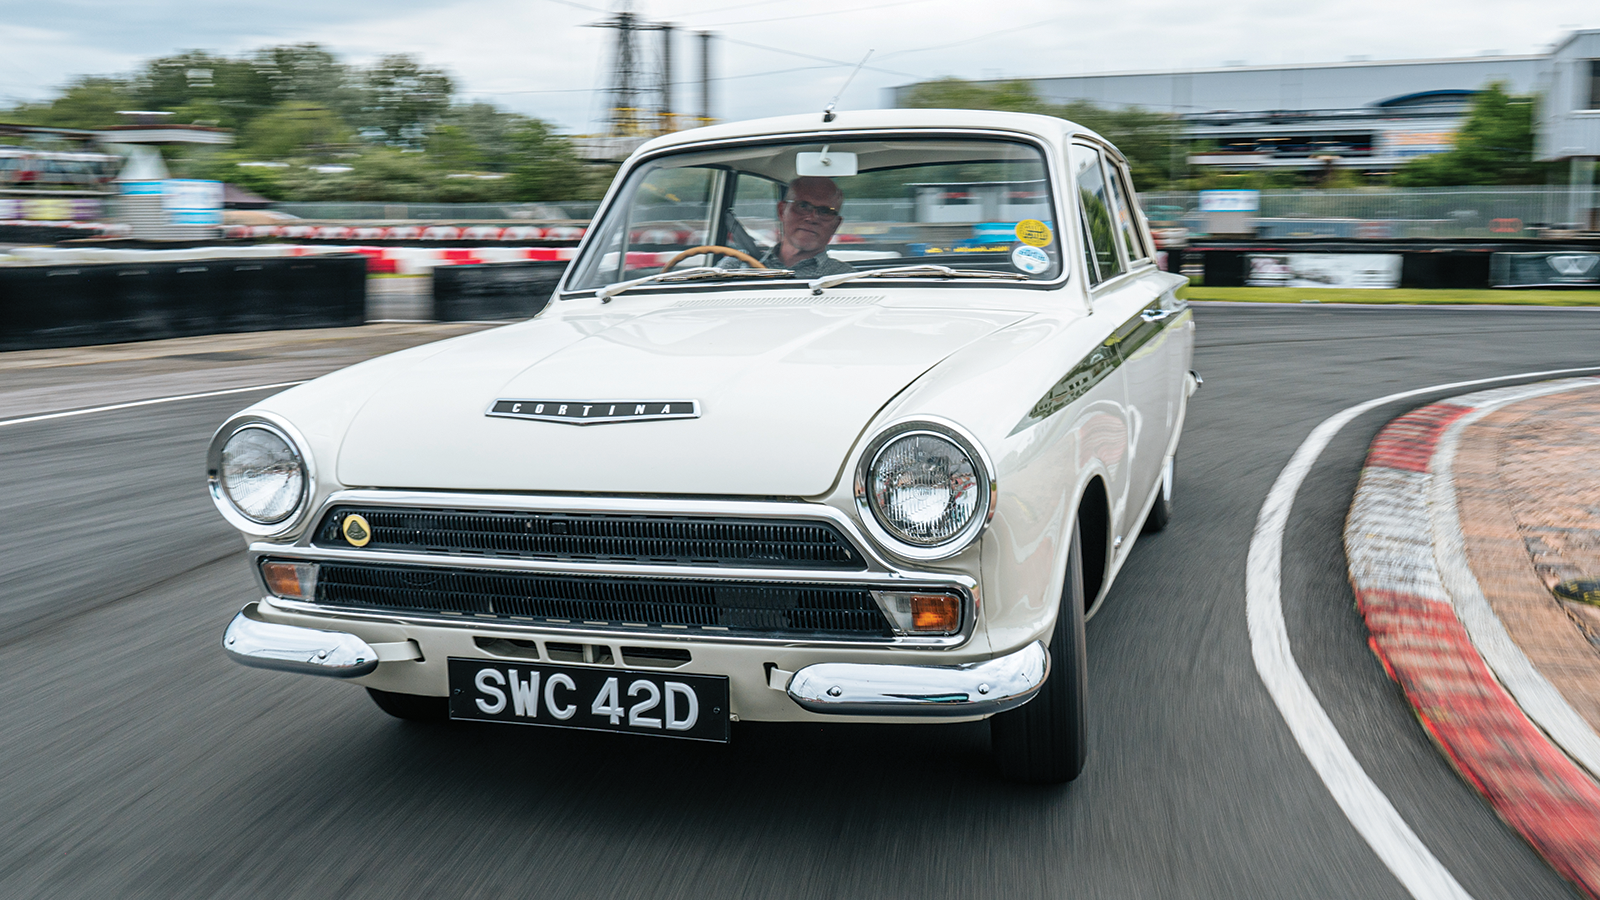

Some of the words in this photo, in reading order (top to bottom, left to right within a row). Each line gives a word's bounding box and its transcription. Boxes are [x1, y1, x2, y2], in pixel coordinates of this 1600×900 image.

[511, 403, 672, 417] CORTINA
[474, 668, 577, 720] SWC
[591, 677, 700, 731] 42D
